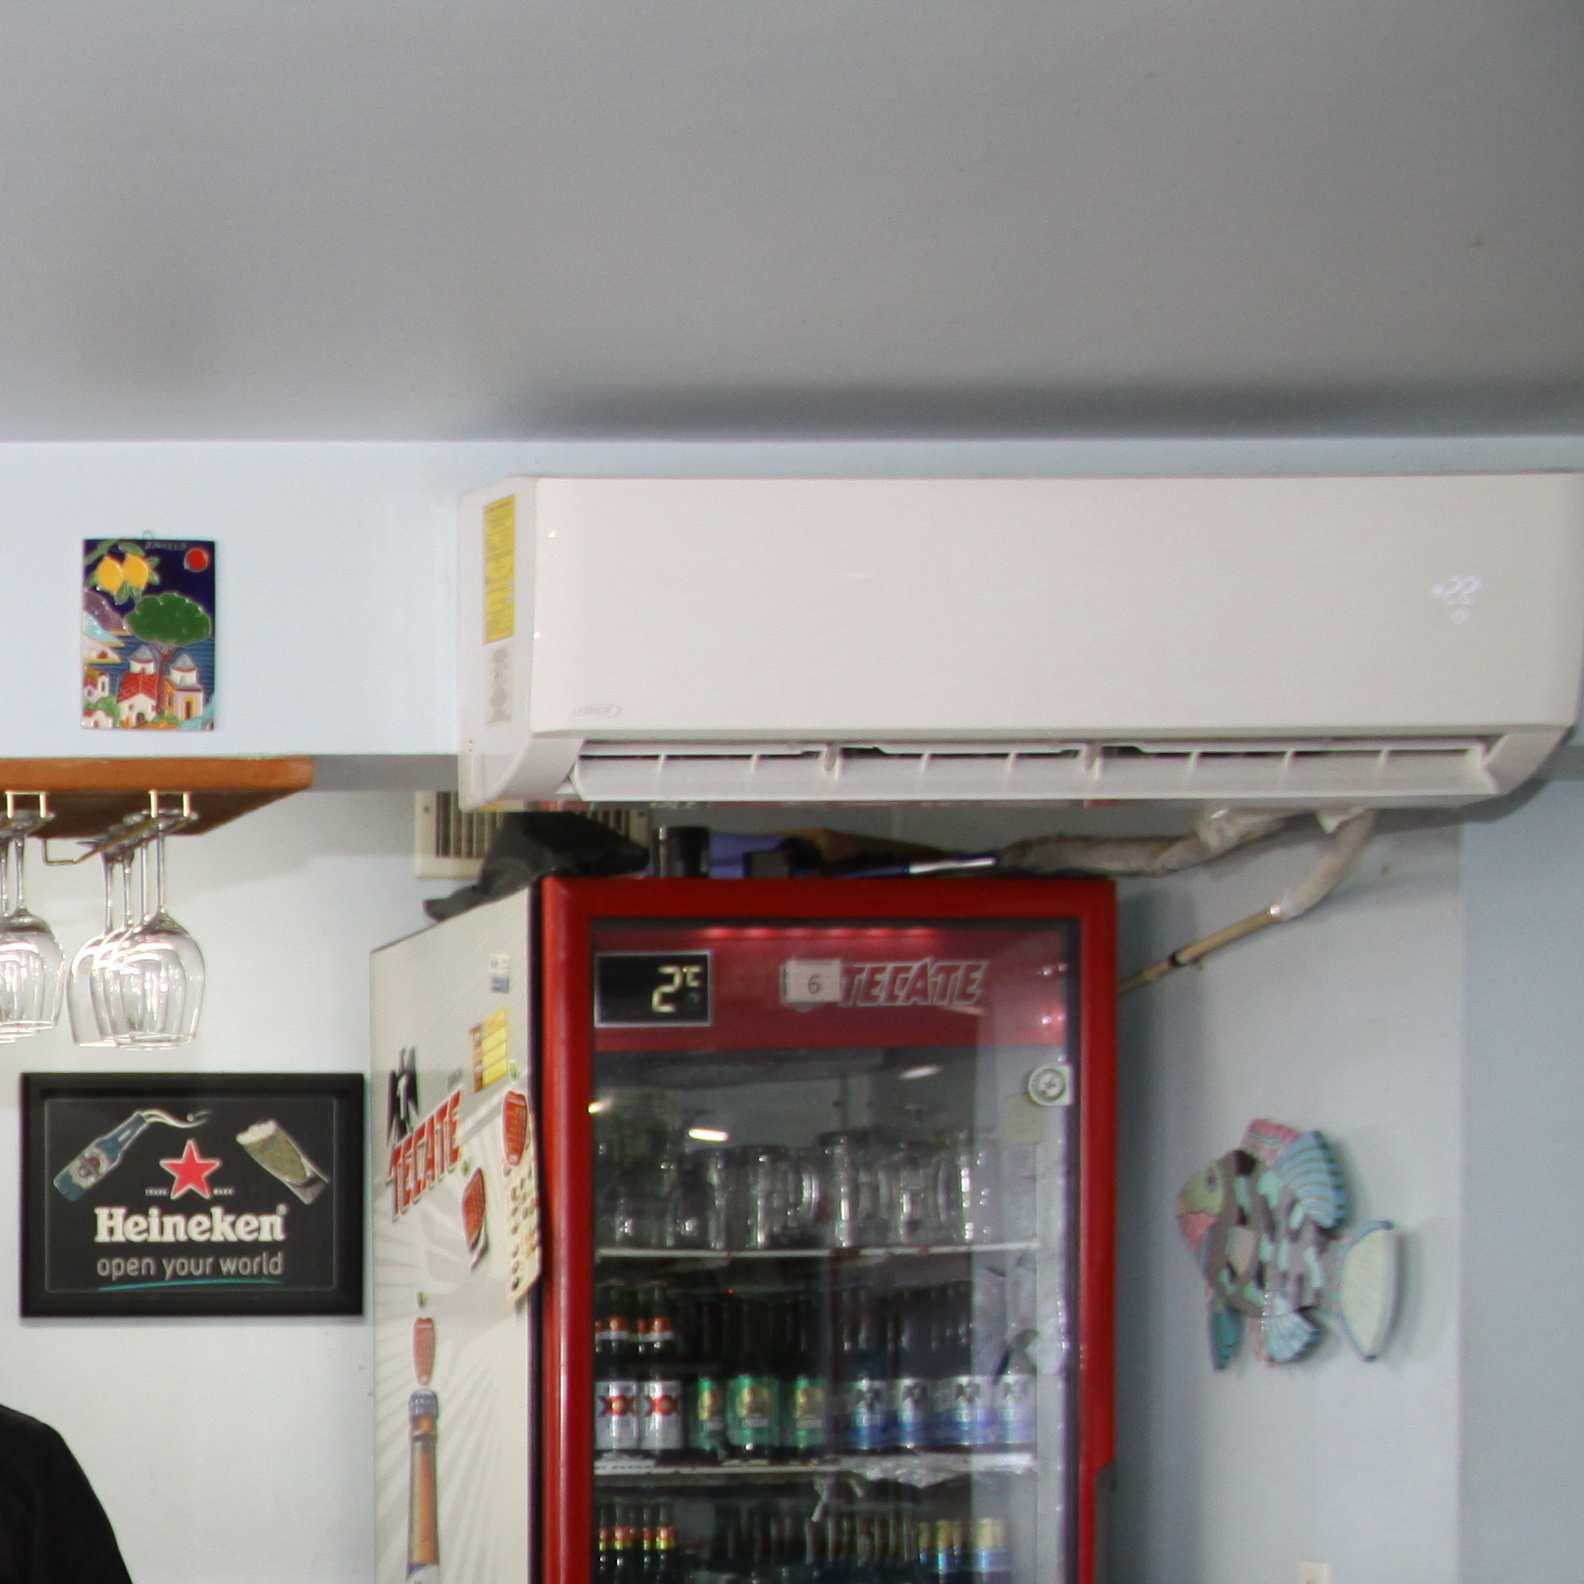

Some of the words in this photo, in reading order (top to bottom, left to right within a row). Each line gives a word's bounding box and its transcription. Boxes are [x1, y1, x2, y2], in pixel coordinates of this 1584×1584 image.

[806, 973, 821, 996] 6
[841, 957, 989, 1007] TECATE
[388, 1088, 464, 1222] TECATE
[94, 1205, 285, 1244] Heineken
[96, 1254, 156, 1281] open
[163, 1254, 214, 1282] your
[219, 1251, 285, 1277] world
